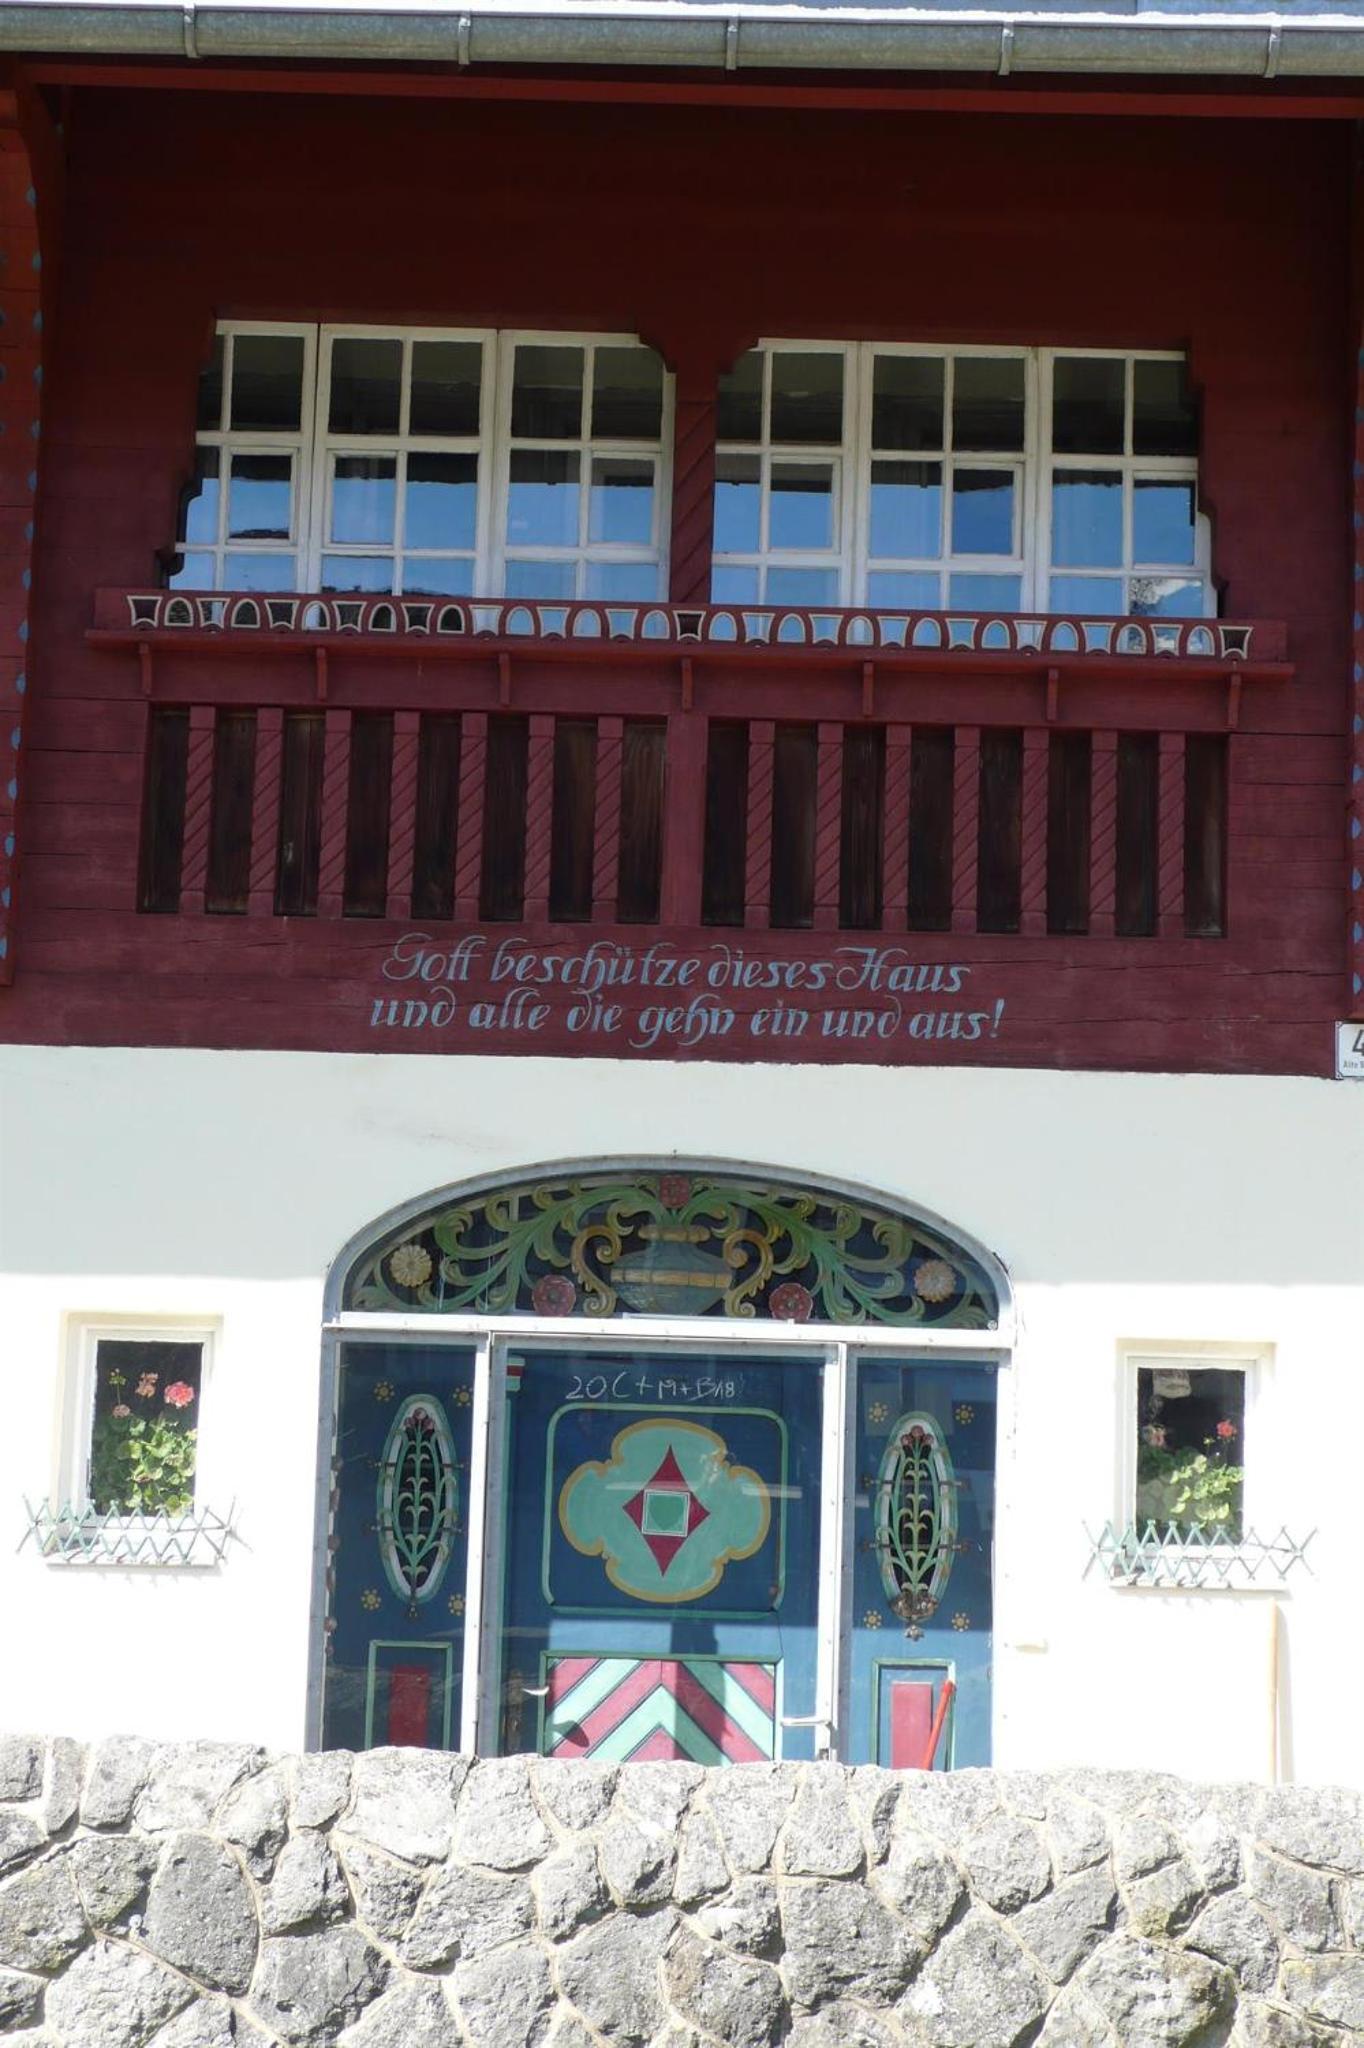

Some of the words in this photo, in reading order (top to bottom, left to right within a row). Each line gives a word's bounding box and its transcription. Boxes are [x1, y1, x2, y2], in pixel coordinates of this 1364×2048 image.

[382, 932, 487, 981] Gott
[490, 937, 701, 994] beschütze
[707, 944, 834, 989] dieses
[836, 947, 971, 992] Haus
[369, 986, 456, 1028] und
[468, 986, 552, 1030] alle
[567, 990, 622, 1032] die
[629, 993, 734, 1048] gehn
[750, 1000, 809, 1036] ein
[821, 995, 902, 1038] und
[908, 998, 1005, 1039] aus!
